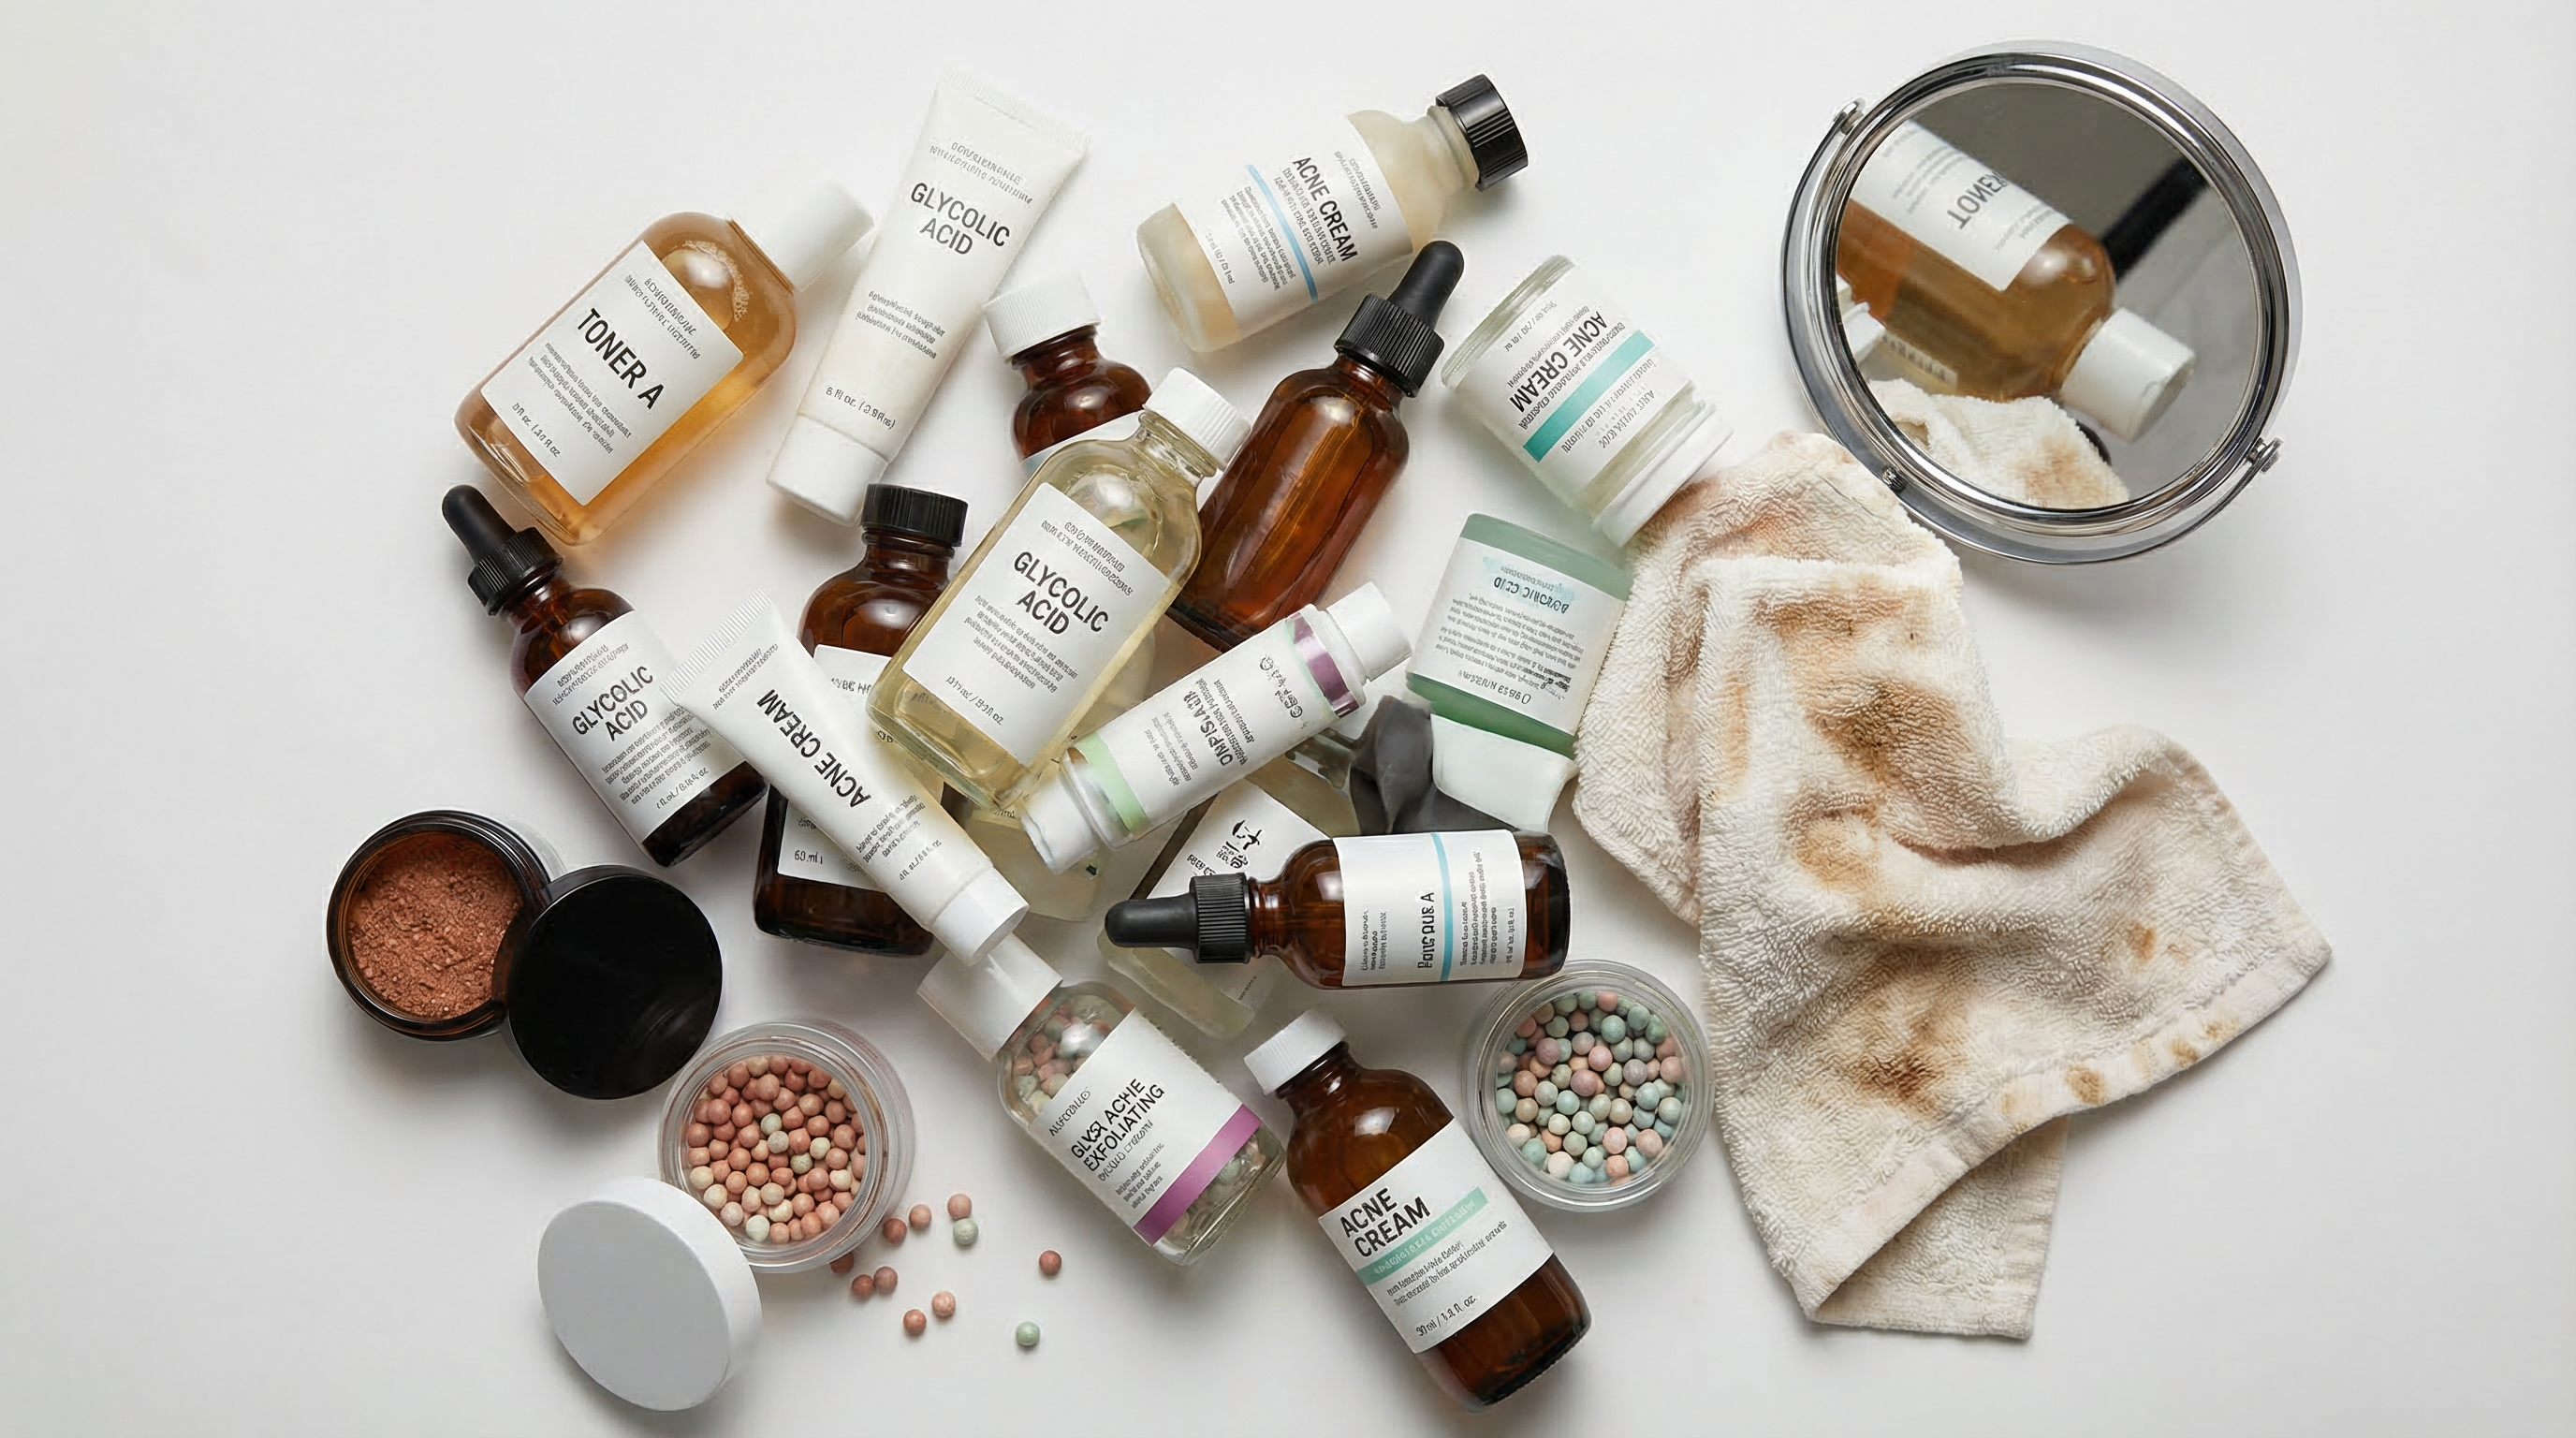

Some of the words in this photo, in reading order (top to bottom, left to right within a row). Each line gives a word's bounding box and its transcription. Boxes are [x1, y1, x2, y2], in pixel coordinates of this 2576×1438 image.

[910, 182, 1011, 247] GLYCOLIC
[919, 217, 973, 256] ACID
[1292, 157, 1330, 202] ACNE
[1319, 200, 1358, 262] CREAM
[577, 307, 647, 389] TONER
[637, 383, 665, 410] A
[1563, 310, 1608, 359] ACNE
[1509, 350, 1569, 414] CREAM
[1013, 550, 1109, 634] GLYCOLIC
[1017, 590, 1071, 636] ACID
[571, 665, 654, 736] GLYCOLIC
[604, 698, 650, 742] ACID
[755, 688, 823, 758] CREAM
[812, 751, 872, 809] ACNE
[1082, 1083, 1166, 1172] EXFOLIATING
[1339, 1186, 1398, 1239] ACNE
[1354, 1196, 1432, 1258] CREAM
